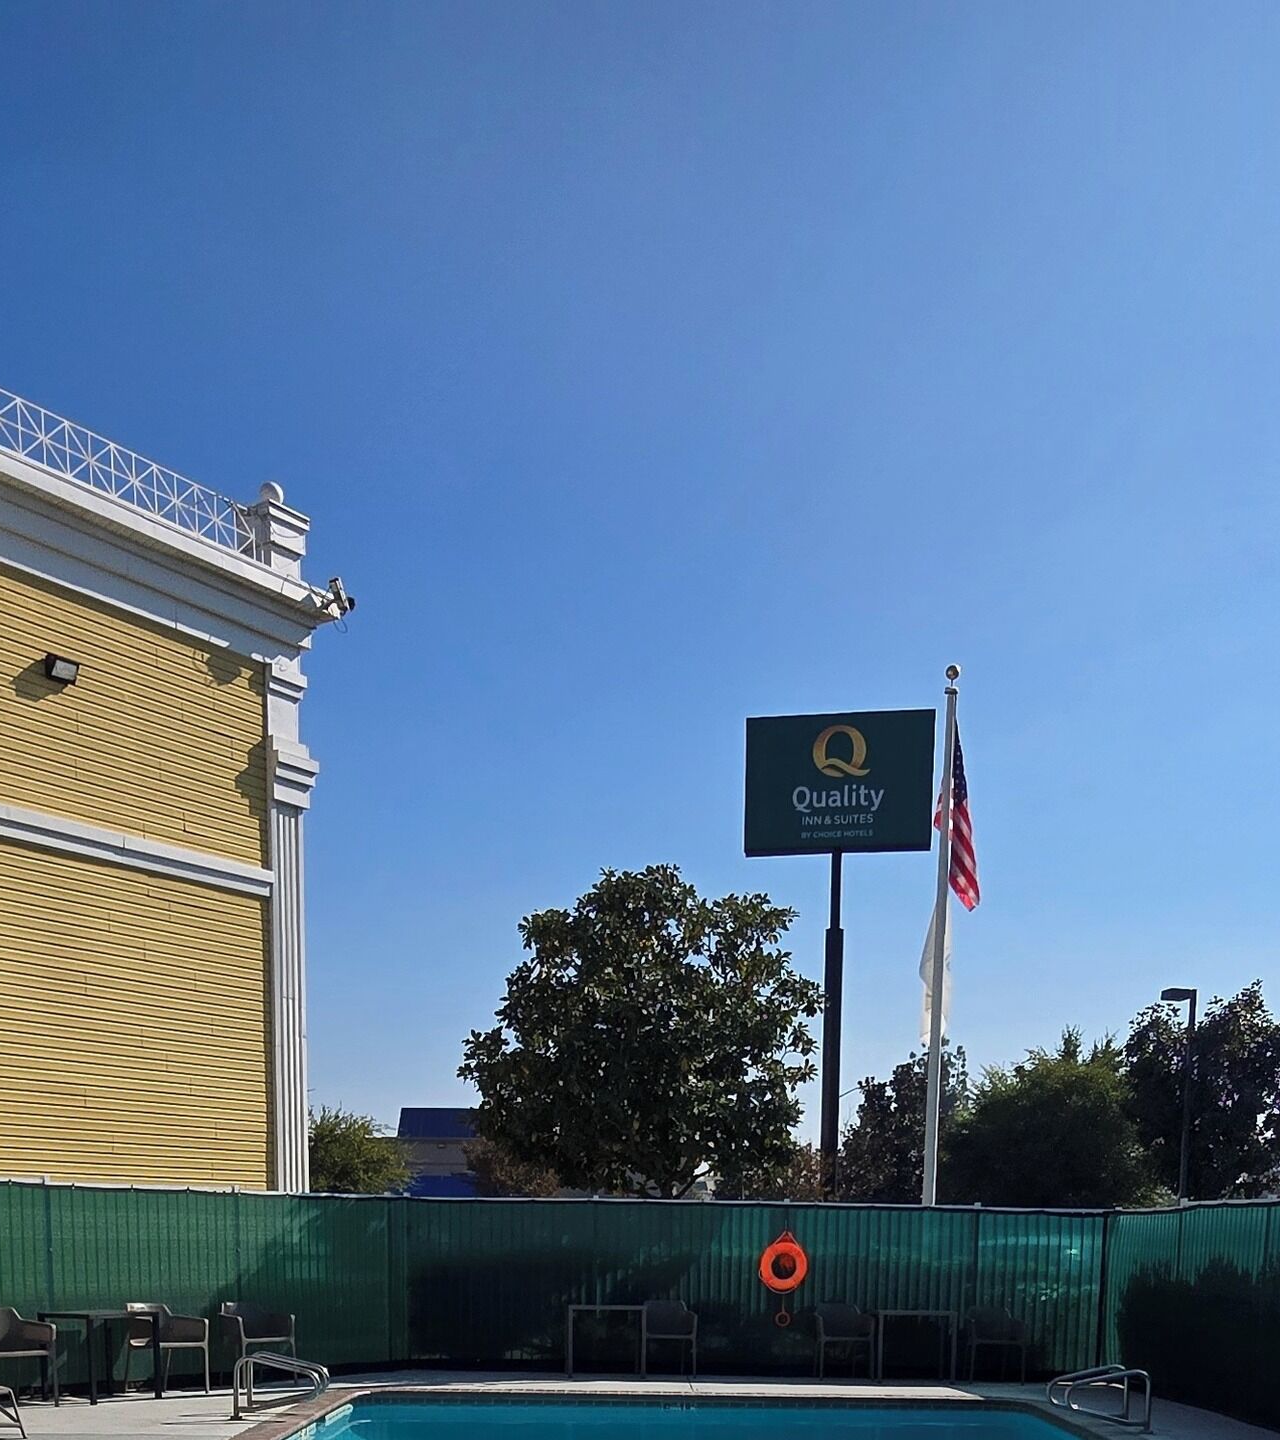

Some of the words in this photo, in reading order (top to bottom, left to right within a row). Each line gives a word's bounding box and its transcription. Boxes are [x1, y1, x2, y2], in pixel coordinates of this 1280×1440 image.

[792, 784, 885, 812] Quality
[801, 816, 822, 825] INN
[823, 815, 832, 825] &
[834, 814, 873, 824] SUITES
[800, 831, 812, 839] BY
[813, 830, 842, 838] CHOICE
[843, 829, 873, 837] HOTELS
